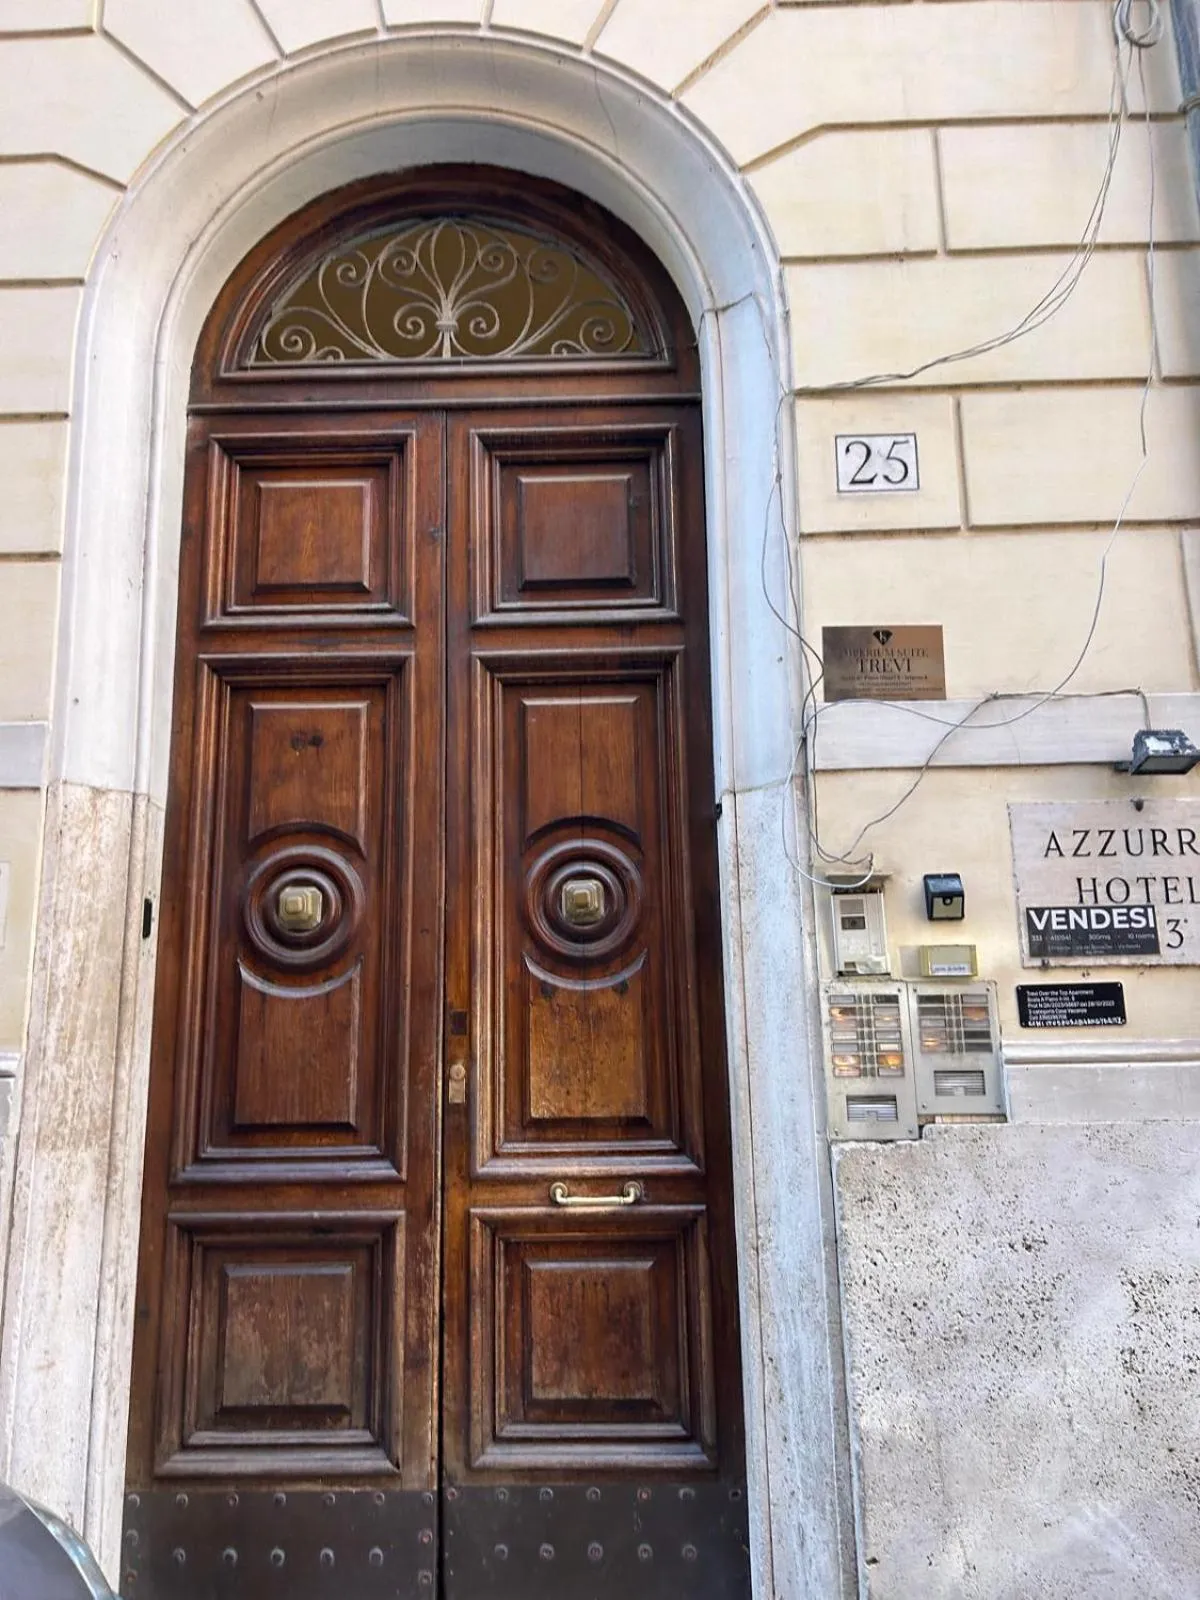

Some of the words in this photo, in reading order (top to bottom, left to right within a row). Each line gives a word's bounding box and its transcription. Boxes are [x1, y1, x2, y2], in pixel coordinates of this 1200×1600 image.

[845, 440, 909, 484] 25
[856, 658, 911, 673] TREVI
[897, 648, 928, 657] SUITE
[1044, 829, 1200, 858] AZZURR
[1075, 876, 1200, 906] HOTEL
[1029, 907, 1155, 930] VENDESI
